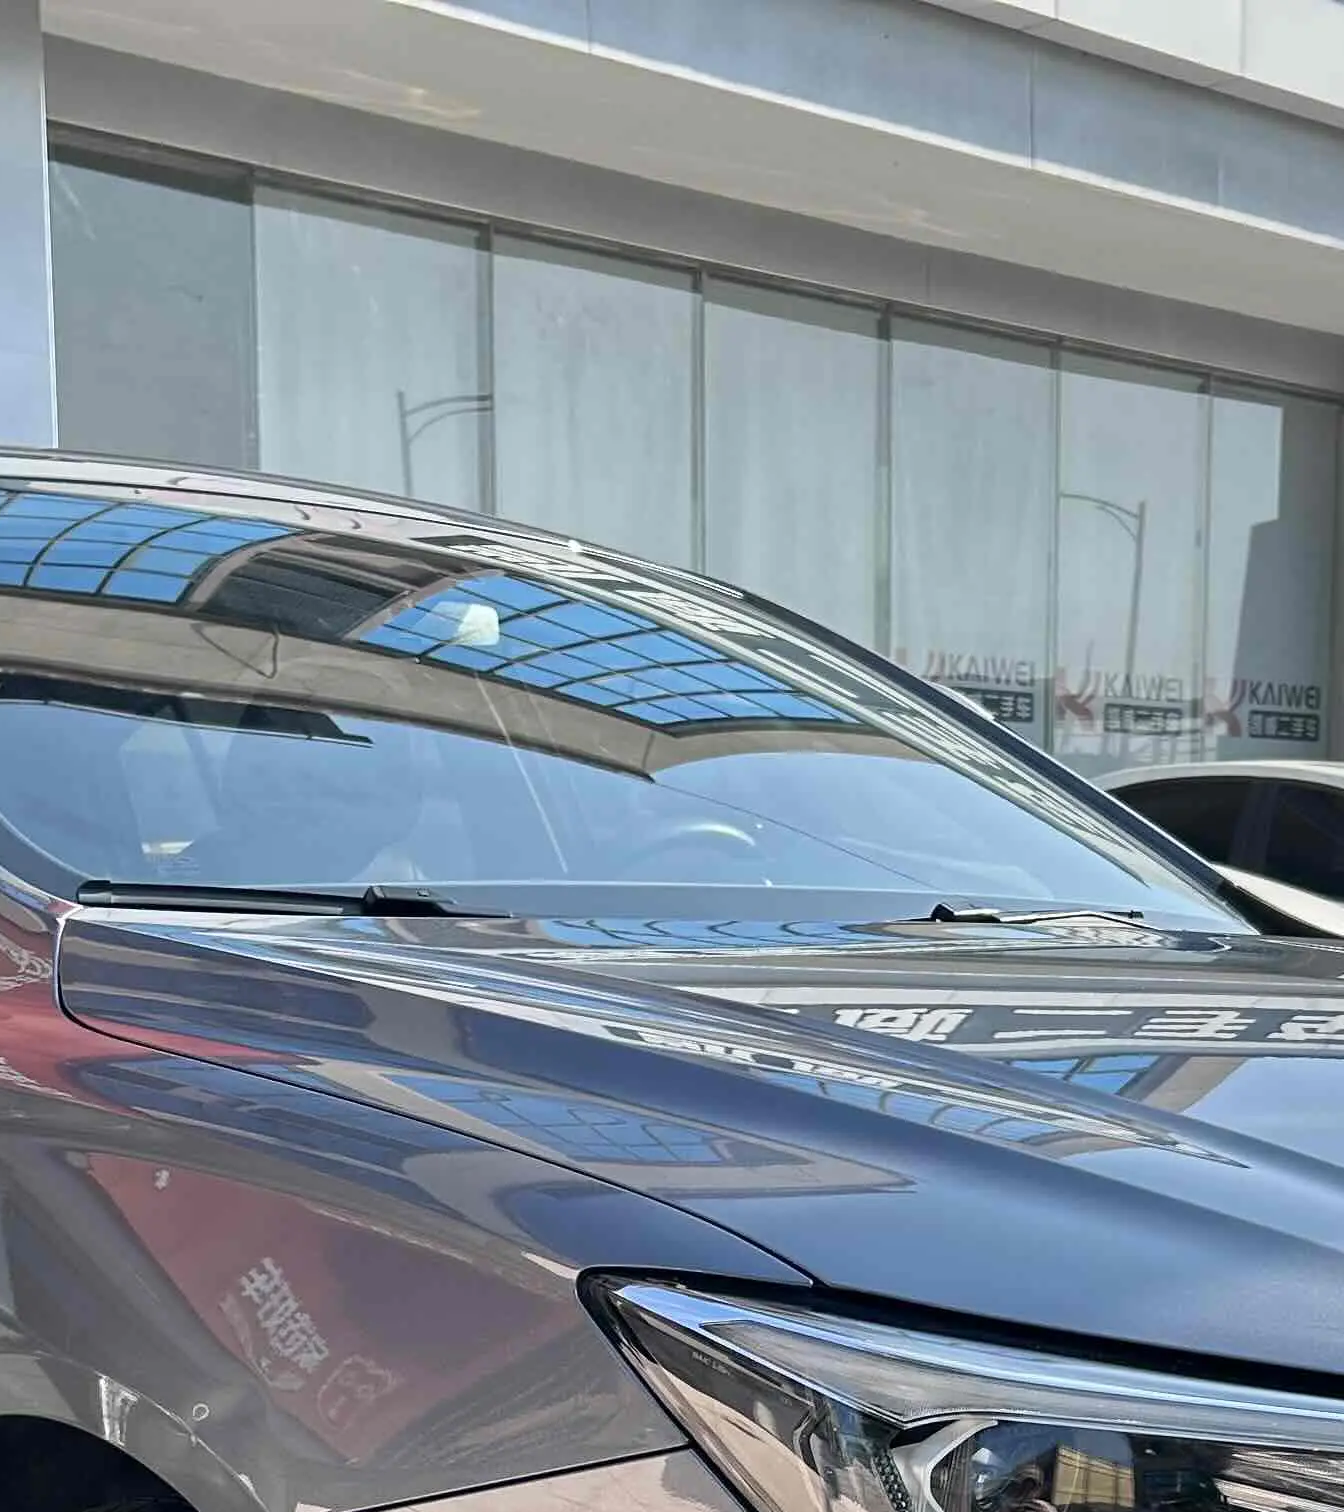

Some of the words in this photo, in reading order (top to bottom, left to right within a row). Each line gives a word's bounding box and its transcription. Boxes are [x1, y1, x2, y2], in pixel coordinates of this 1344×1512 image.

[946, 653, 1037, 688] KAIWEI
[1103, 671, 1185, 703] KAIWEI
[1248, 680, 1321, 709] KAIWEI
